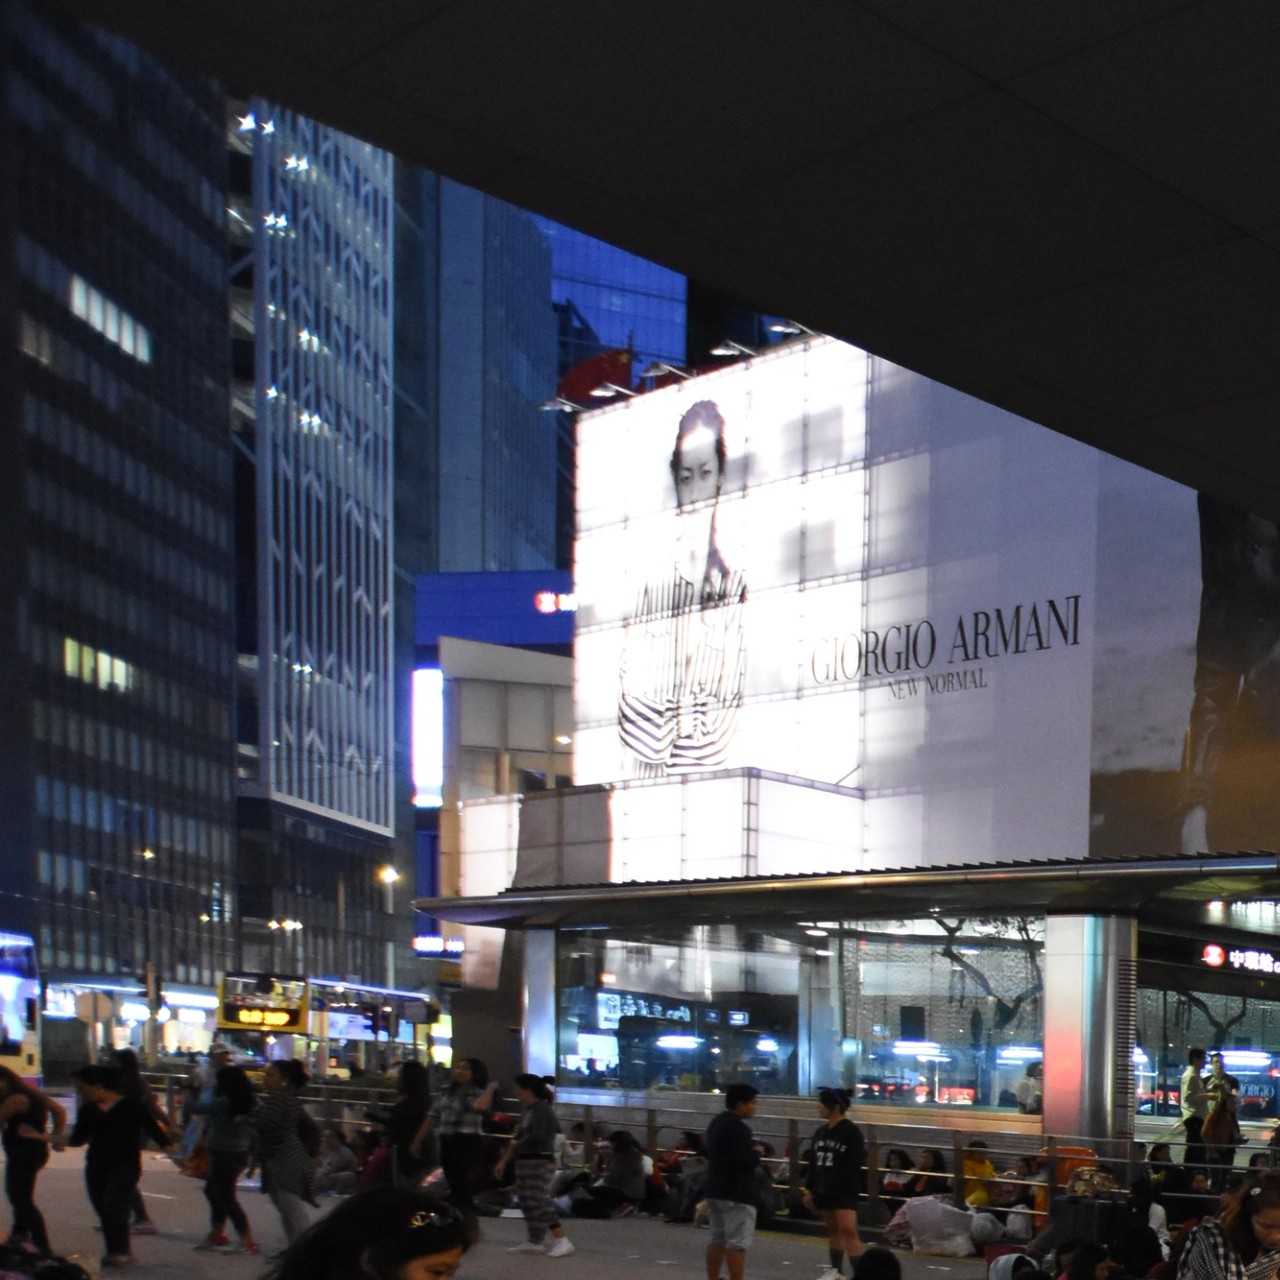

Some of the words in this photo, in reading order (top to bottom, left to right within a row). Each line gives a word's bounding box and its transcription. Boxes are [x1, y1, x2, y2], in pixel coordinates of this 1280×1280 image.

[811, 620, 937, 685] GIORGIO
[948, 595, 1082, 663] ARMANI
[888, 680, 921, 701] NEW
[924, 668, 988, 697] NORMAL
